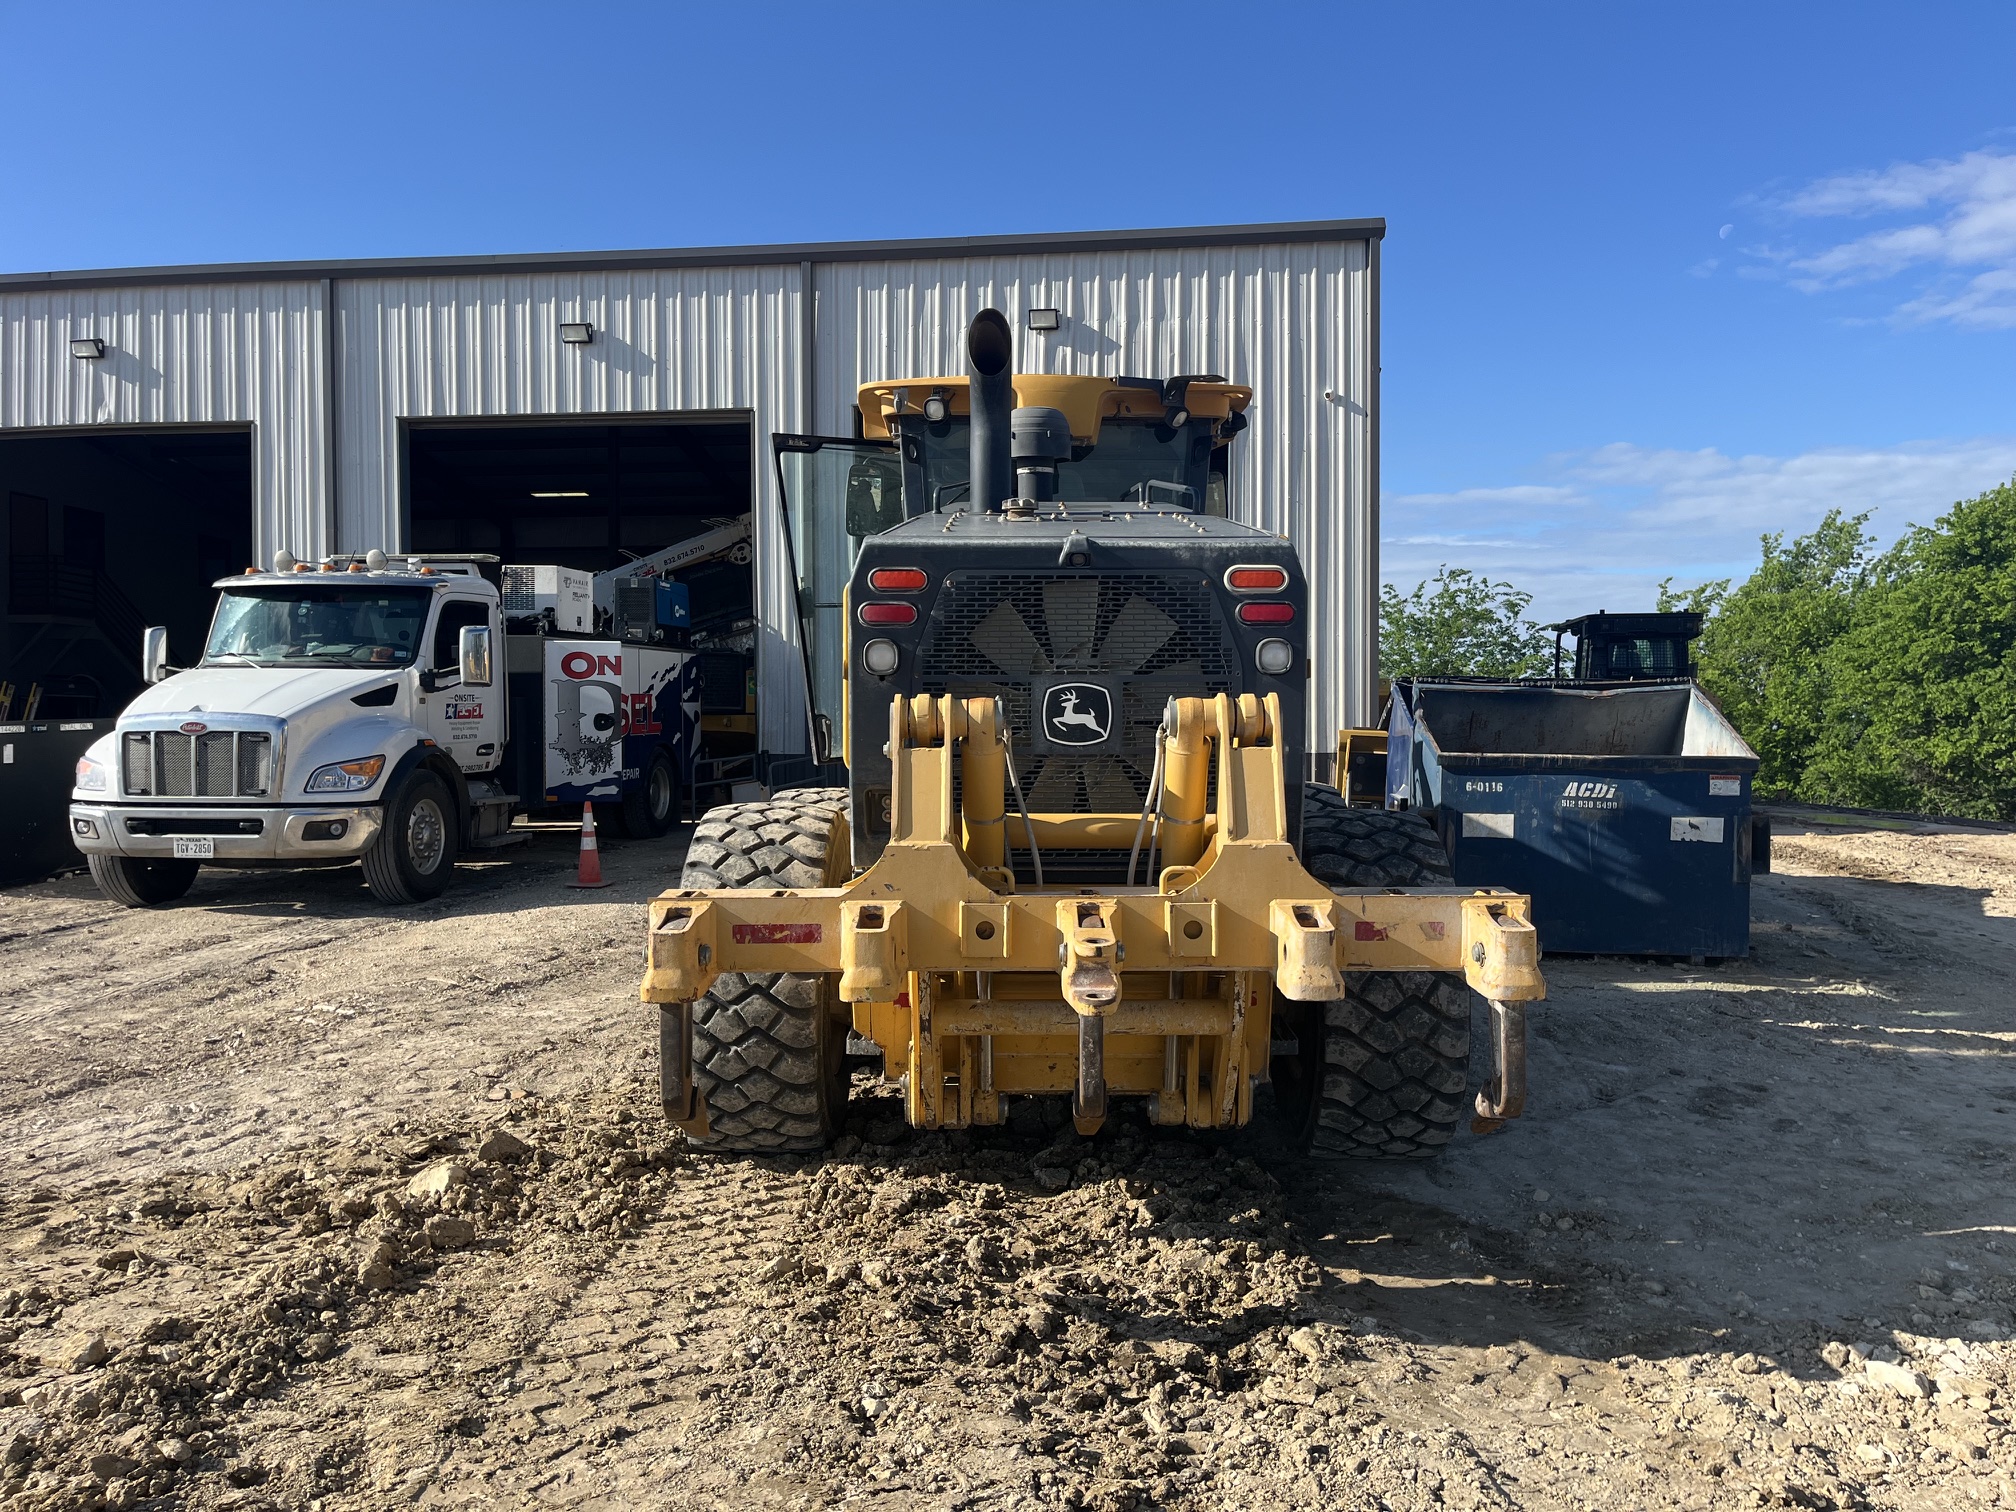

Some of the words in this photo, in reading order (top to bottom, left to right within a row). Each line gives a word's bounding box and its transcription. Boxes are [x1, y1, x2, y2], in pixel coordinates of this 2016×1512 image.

[663, 544, 705, 566] 832.674.5710
[454, 694, 475, 702] ONSITE
[622, 767, 640, 781] EPAIR
[1561, 799, 1575, 808] 512
